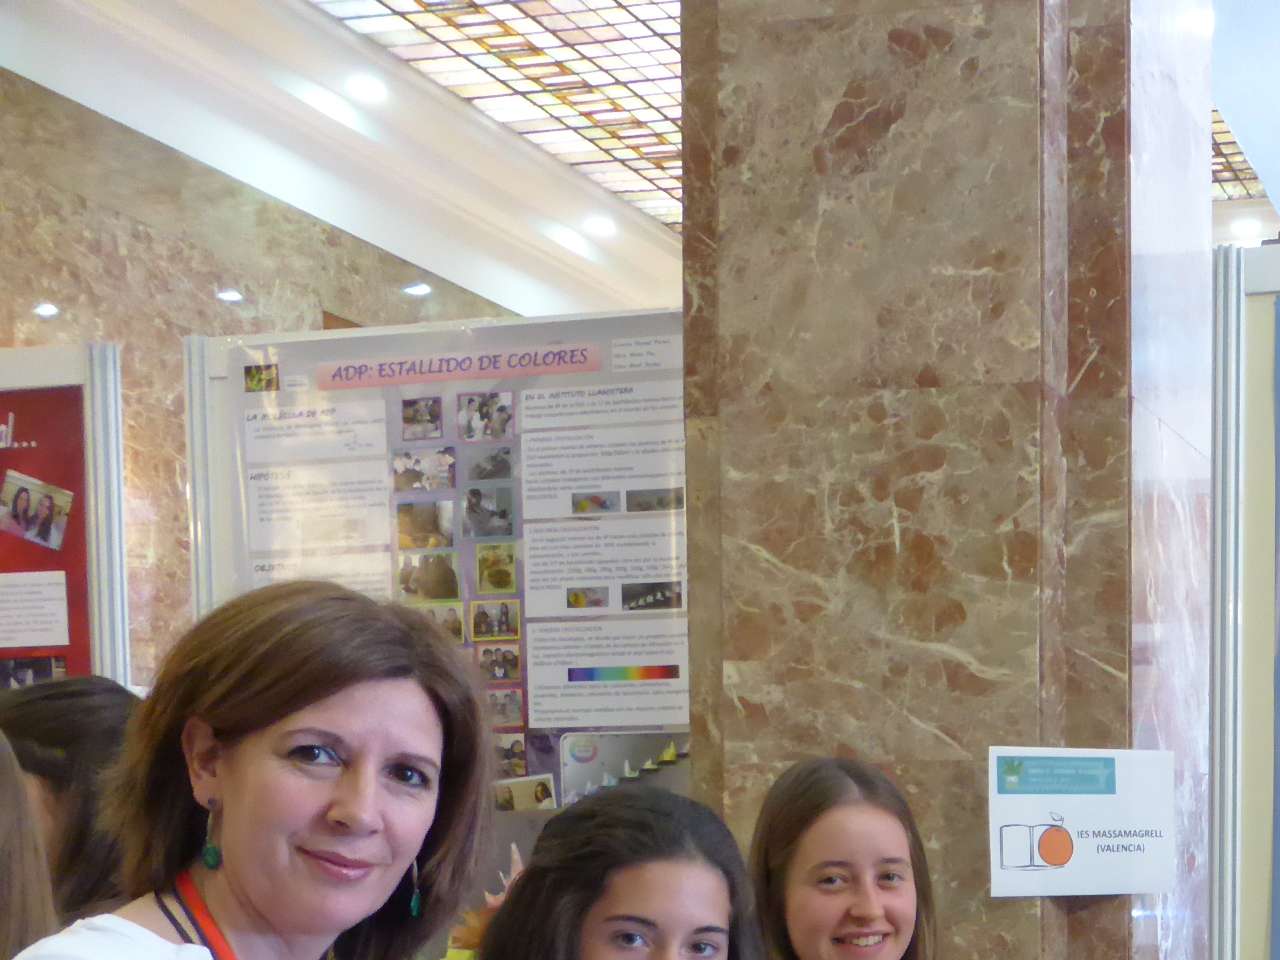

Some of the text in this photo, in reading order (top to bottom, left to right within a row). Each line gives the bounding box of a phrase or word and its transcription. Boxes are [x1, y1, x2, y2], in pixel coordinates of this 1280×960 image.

[377, 356, 472, 378] ESTALLIDO
[478, 354, 502, 371] DE
[507, 348, 589, 369] COLORES
[1077, 829, 1164, 839] IES MASSAMAGRELL
[1096, 843, 1145, 854] (VALENCIA)
